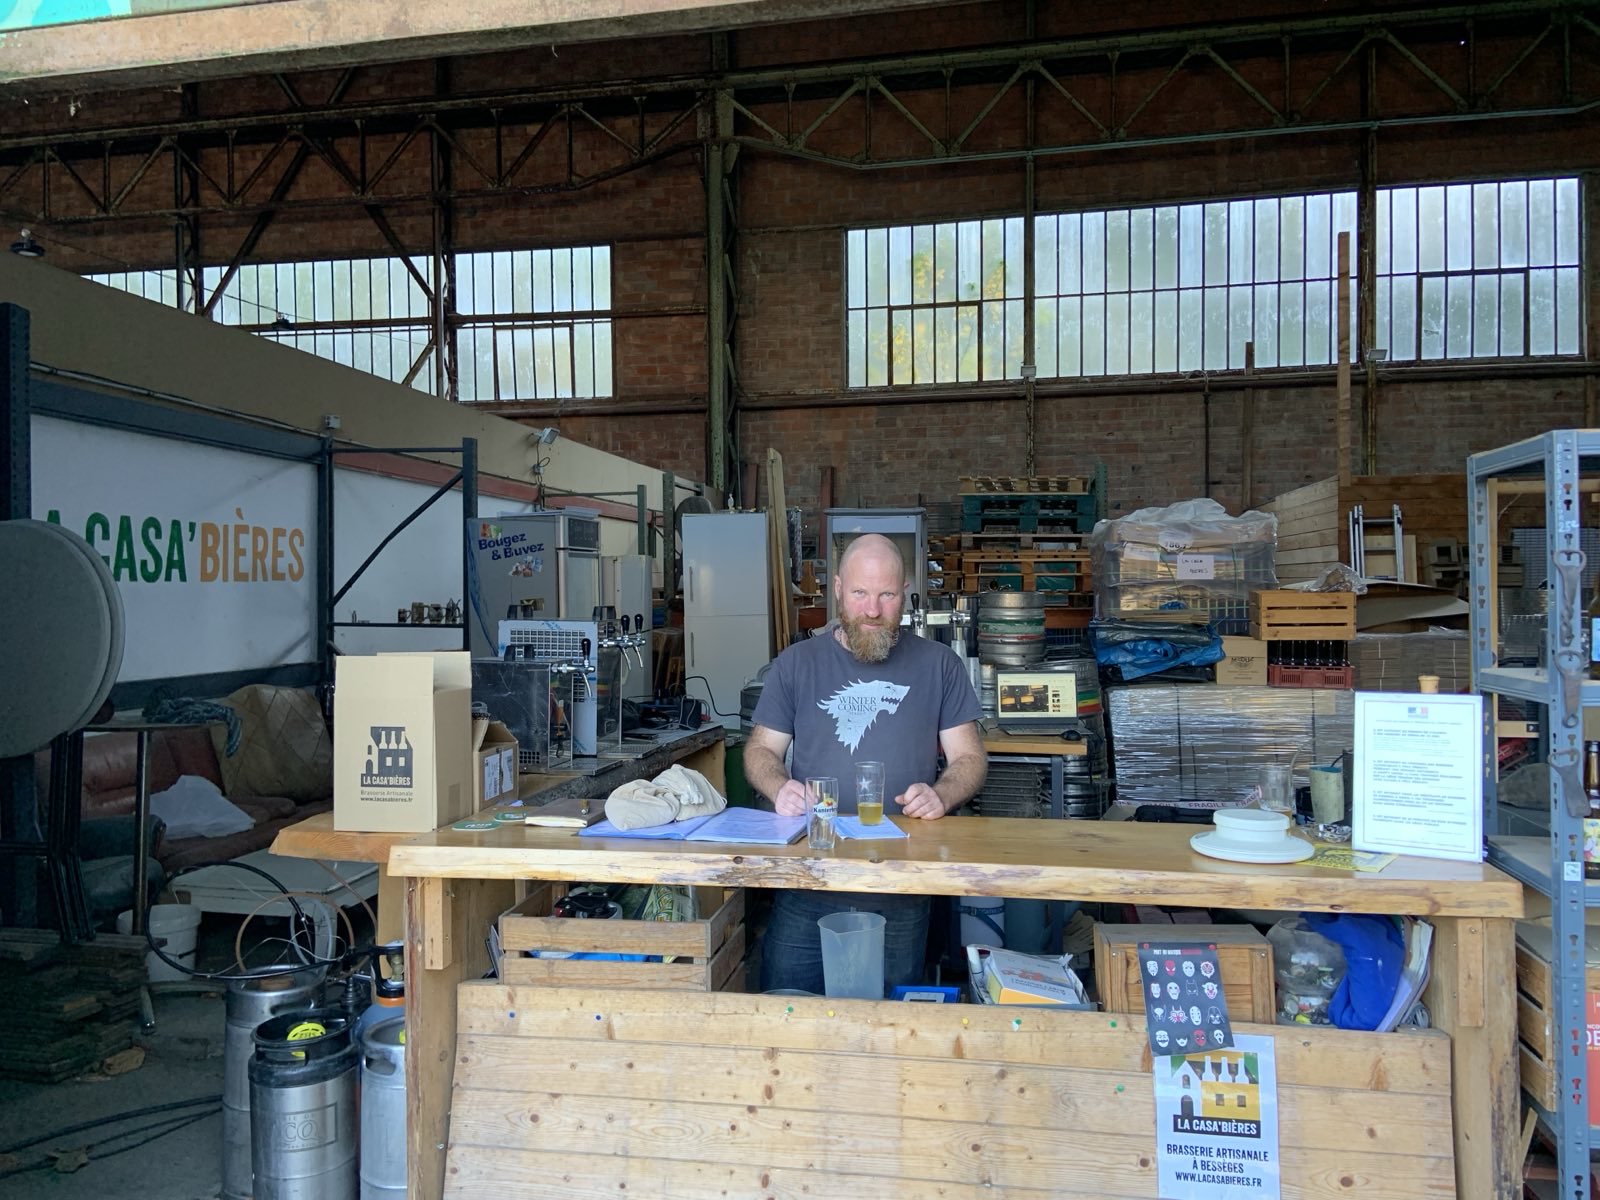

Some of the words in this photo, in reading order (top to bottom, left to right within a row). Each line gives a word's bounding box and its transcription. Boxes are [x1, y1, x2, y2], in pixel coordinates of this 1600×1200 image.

[478, 533, 527, 550] Bougez
[492, 549, 502, 560] &
[504, 543, 544, 558] Buvez
[837, 704, 877, 712] COMING
[838, 696, 877, 704] WINTER
[363, 776, 371, 785] LA
[1177, 1118, 1190, 1130] LA
[1193, 1119, 1257, 1135] CASA'BIÈRES
[1166, 1143, 1214, 1158] BRASSERIE
[1216, 1147, 1269, 1162] ARTISANALE
[1192, 1157, 1199, 1170] À
[1200, 1158, 1244, 1174] BESSÈGES
[1175, 1171, 1262, 1188] WWW.LACASABIERES.FR
